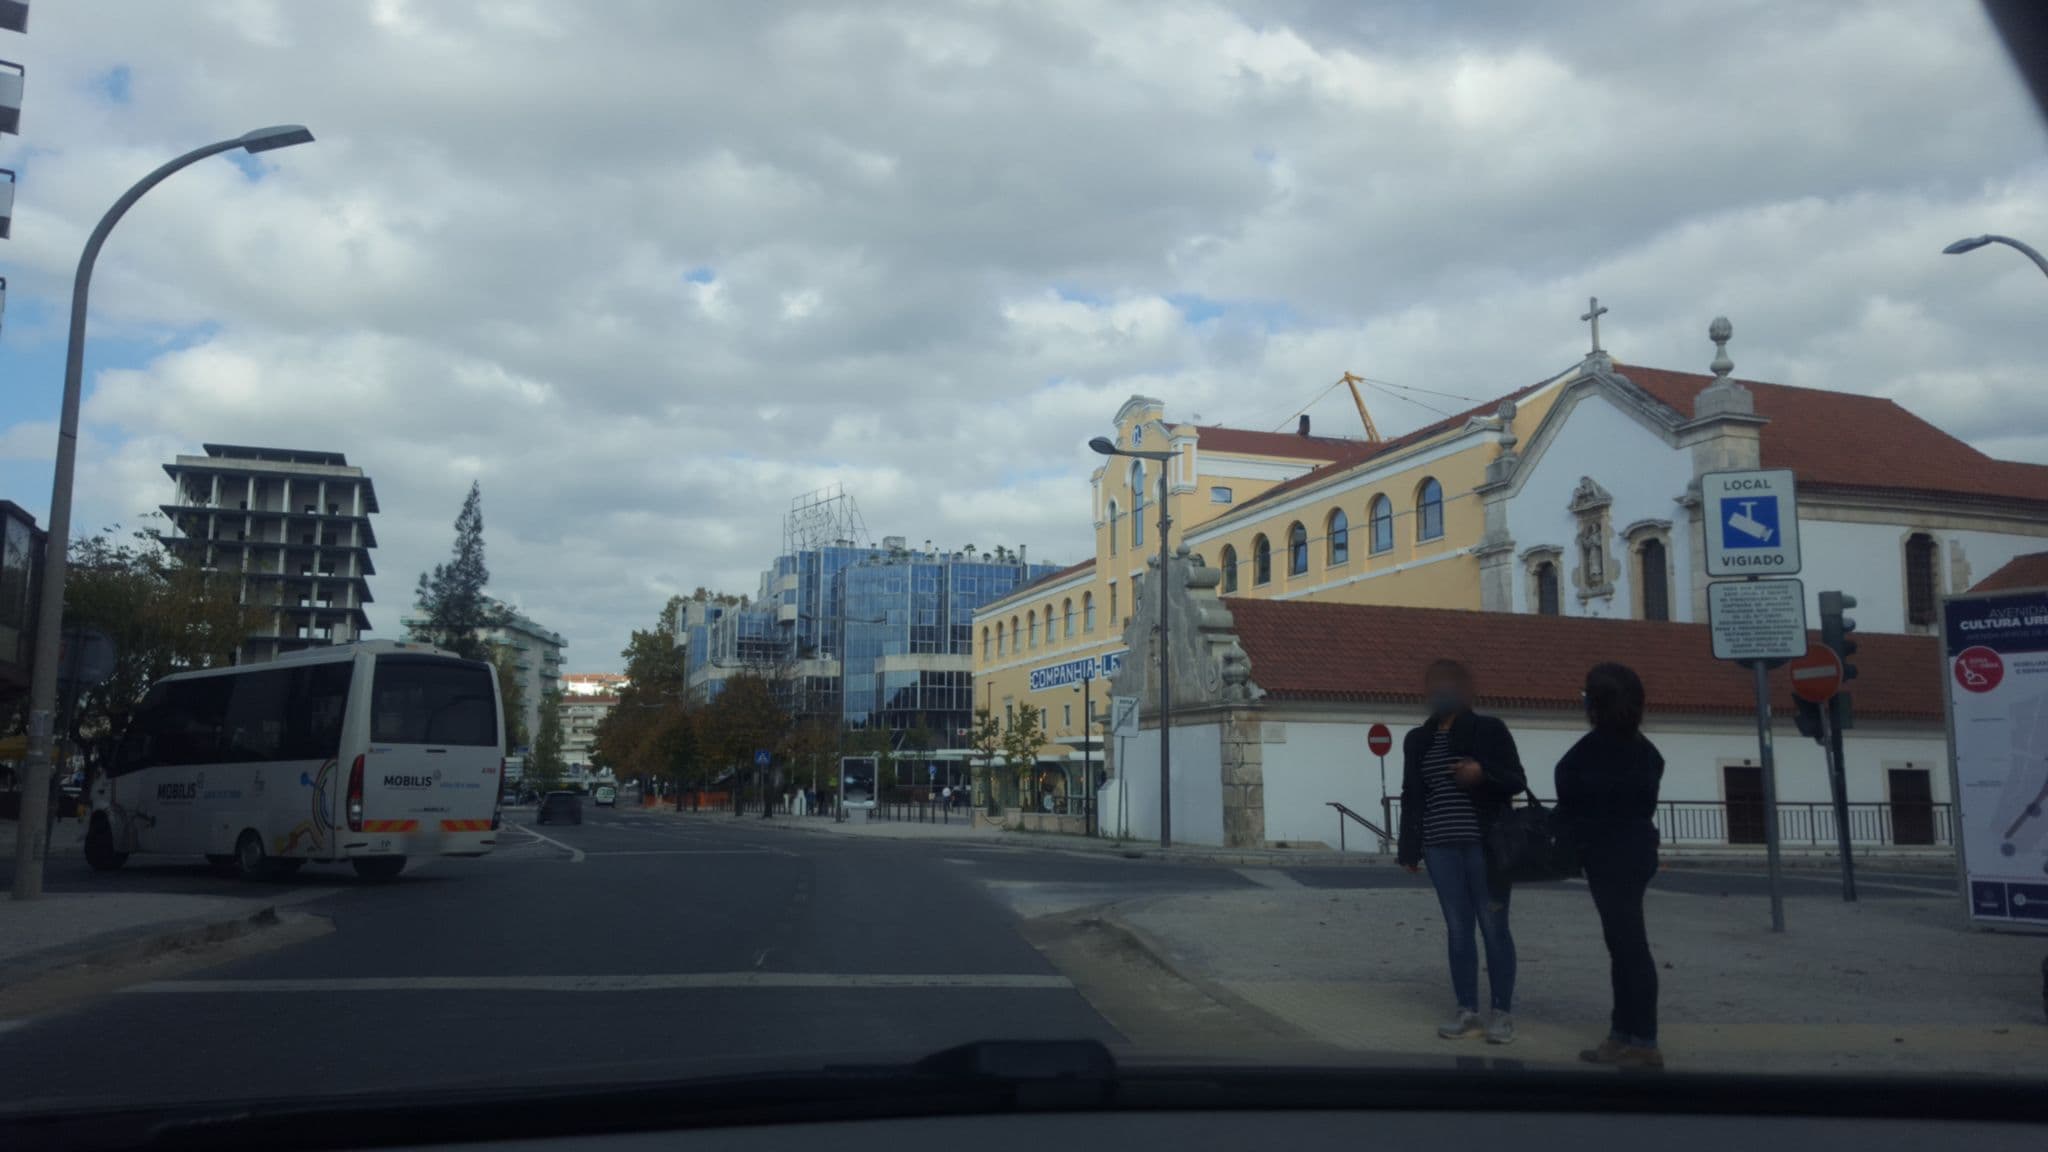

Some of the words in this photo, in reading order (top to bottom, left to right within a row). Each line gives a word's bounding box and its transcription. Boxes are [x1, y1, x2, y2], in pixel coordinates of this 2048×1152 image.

[1723, 479, 1772, 491] LOCAL
[1721, 554, 1784, 567] VIGIADO
[1989, 605, 2048, 619] AVENIDA
[1960, 616, 2021, 631] CULTURA
[384, 775, 432, 788] MOBILIS
[157, 782, 196, 801] MOBILIS
